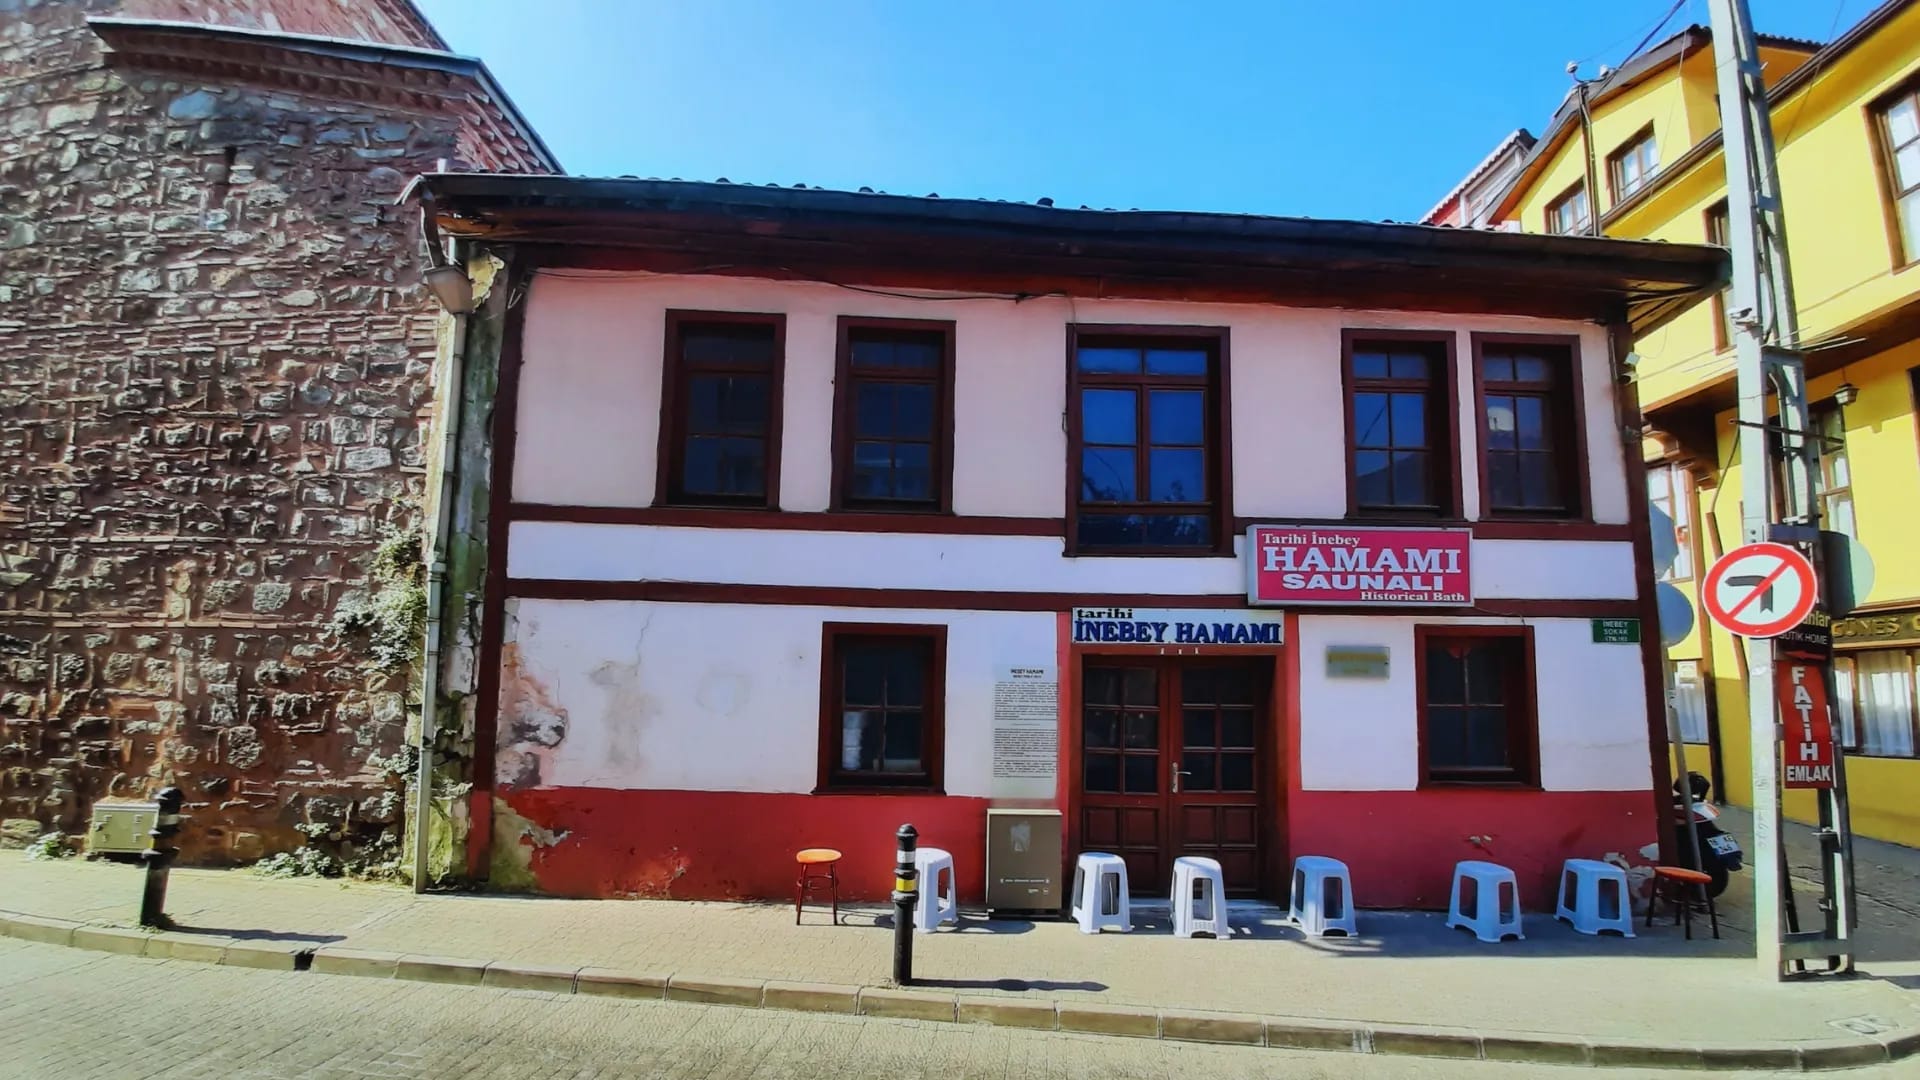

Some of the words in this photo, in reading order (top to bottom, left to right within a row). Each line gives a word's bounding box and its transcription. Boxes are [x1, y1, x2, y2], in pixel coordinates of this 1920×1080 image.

[1262, 533, 1307, 545] Tarihi
[1311, 531, 1361, 547] İnebey
[1263, 547, 1462, 573] HAMAMI
[1282, 573, 1444, 591] SAUNALI
[1360, 591, 1428, 602] Historical
[1433, 592, 1465, 602] Bath
[1076, 608, 1133, 619] tarihi
[1802, 610, 1831, 627] anlar
[1074, 618, 1169, 642] İNEBEY
[1175, 622, 1282, 644] HAMAMI
[1804, 632, 1829, 645] HOME
[1786, 764, 1831, 782] EMLAK
